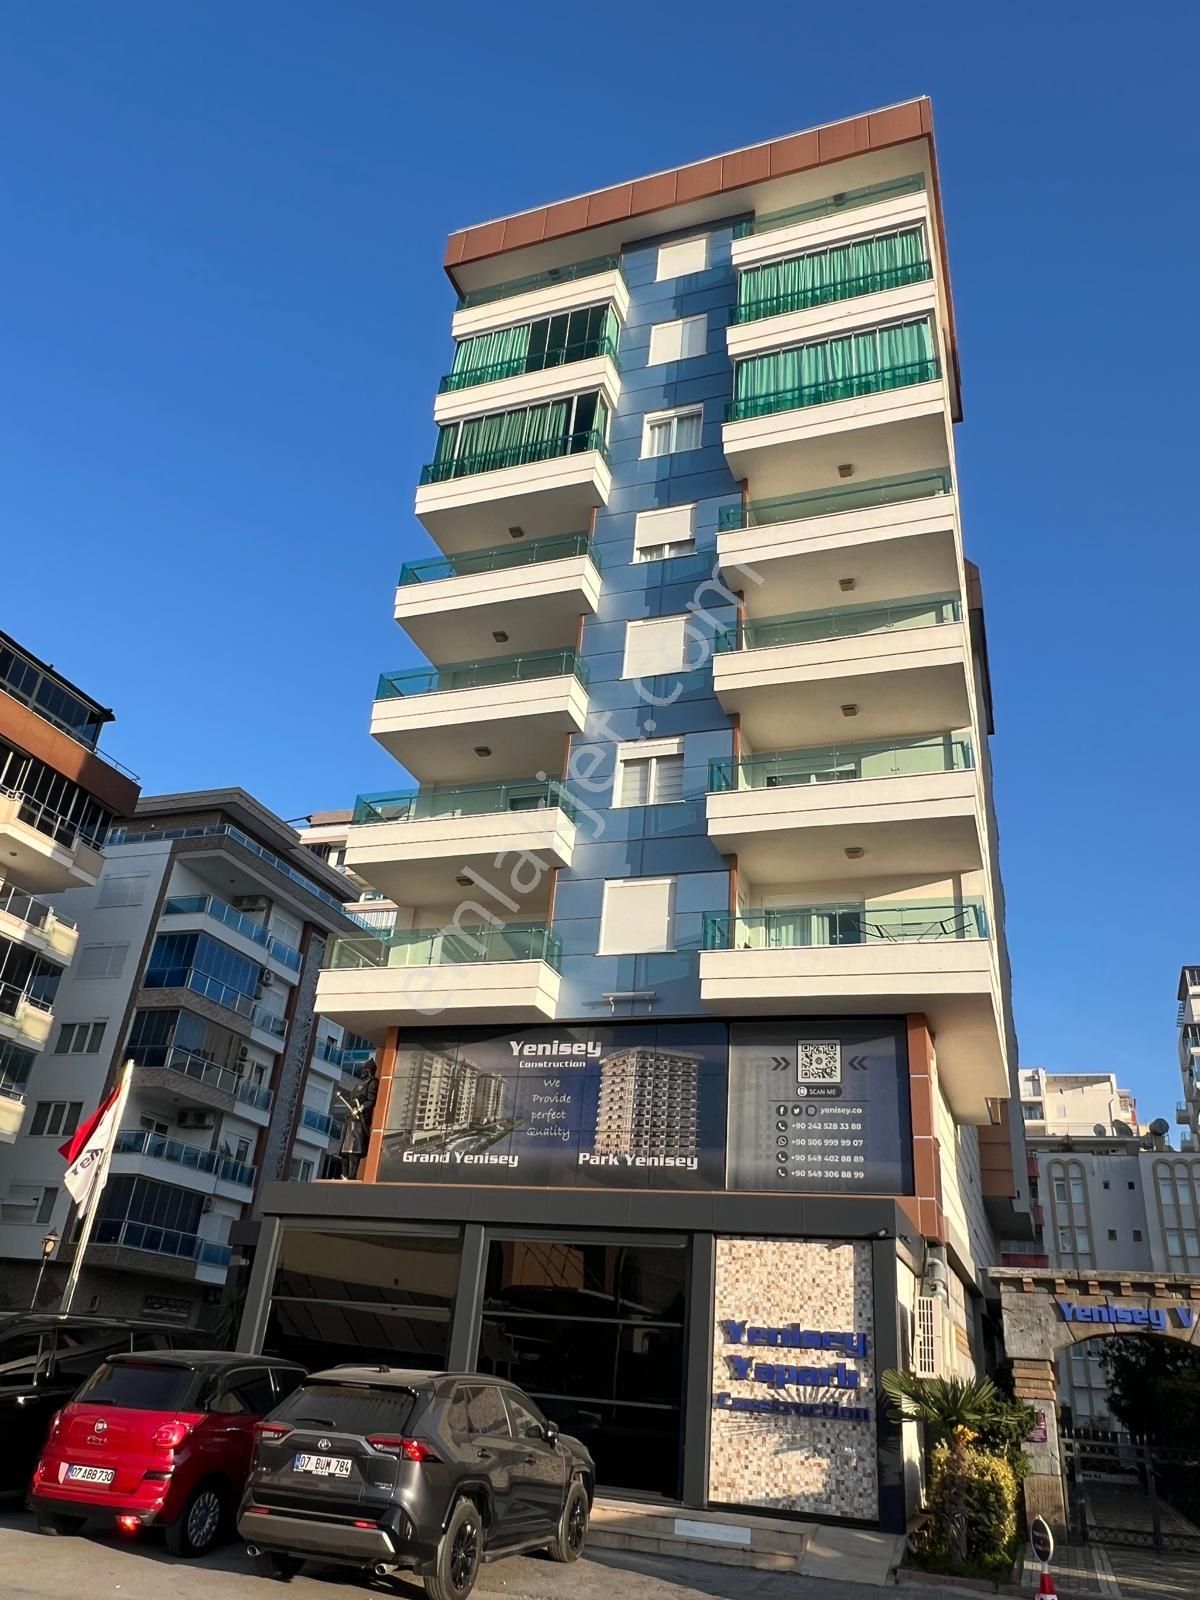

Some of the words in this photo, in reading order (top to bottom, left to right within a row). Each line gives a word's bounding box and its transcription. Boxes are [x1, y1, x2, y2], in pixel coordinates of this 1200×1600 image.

[509, 1040, 602, 1057] Yenisey
[520, 1060, 586, 1068] Construction
[543, 1079, 561, 1088] We
[532, 1093, 571, 1104] Provide
[531, 1110, 567, 1121] perfect
[791, 1122, 806, 1130] +90
[807, 1122, 822, 1130] 242
[526, 1127, 570, 1141] Quality
[791, 1138, 806, 1146] +90
[807, 1138, 823, 1146] 506
[823, 1139, 839, 1147] 999
[840, 1139, 851, 1147] 99
[852, 1139, 864, 1147] 07
[402, 1151, 450, 1164] Grand
[454, 1151, 519, 1168] Yenisey
[578, 1152, 620, 1166] Park
[624, 1153, 698, 1170] Yenisey
[807, 1154, 822, 1162] 549
[807, 1170, 822, 1178] 549
[823, 1170, 840, 1178] 306
[853, 1171, 865, 1179] 99
[1059, 1301, 1167, 1331] Yenisey
[718, 1320, 866, 1358] Yenisey
[715, 1391, 869, 1422] Construction
[301, 1455, 310, 1469] 07
[334, 1460, 349, 1473] 784
[71, 1467, 82, 1477] 07
[97, 1472, 113, 1482] 730
